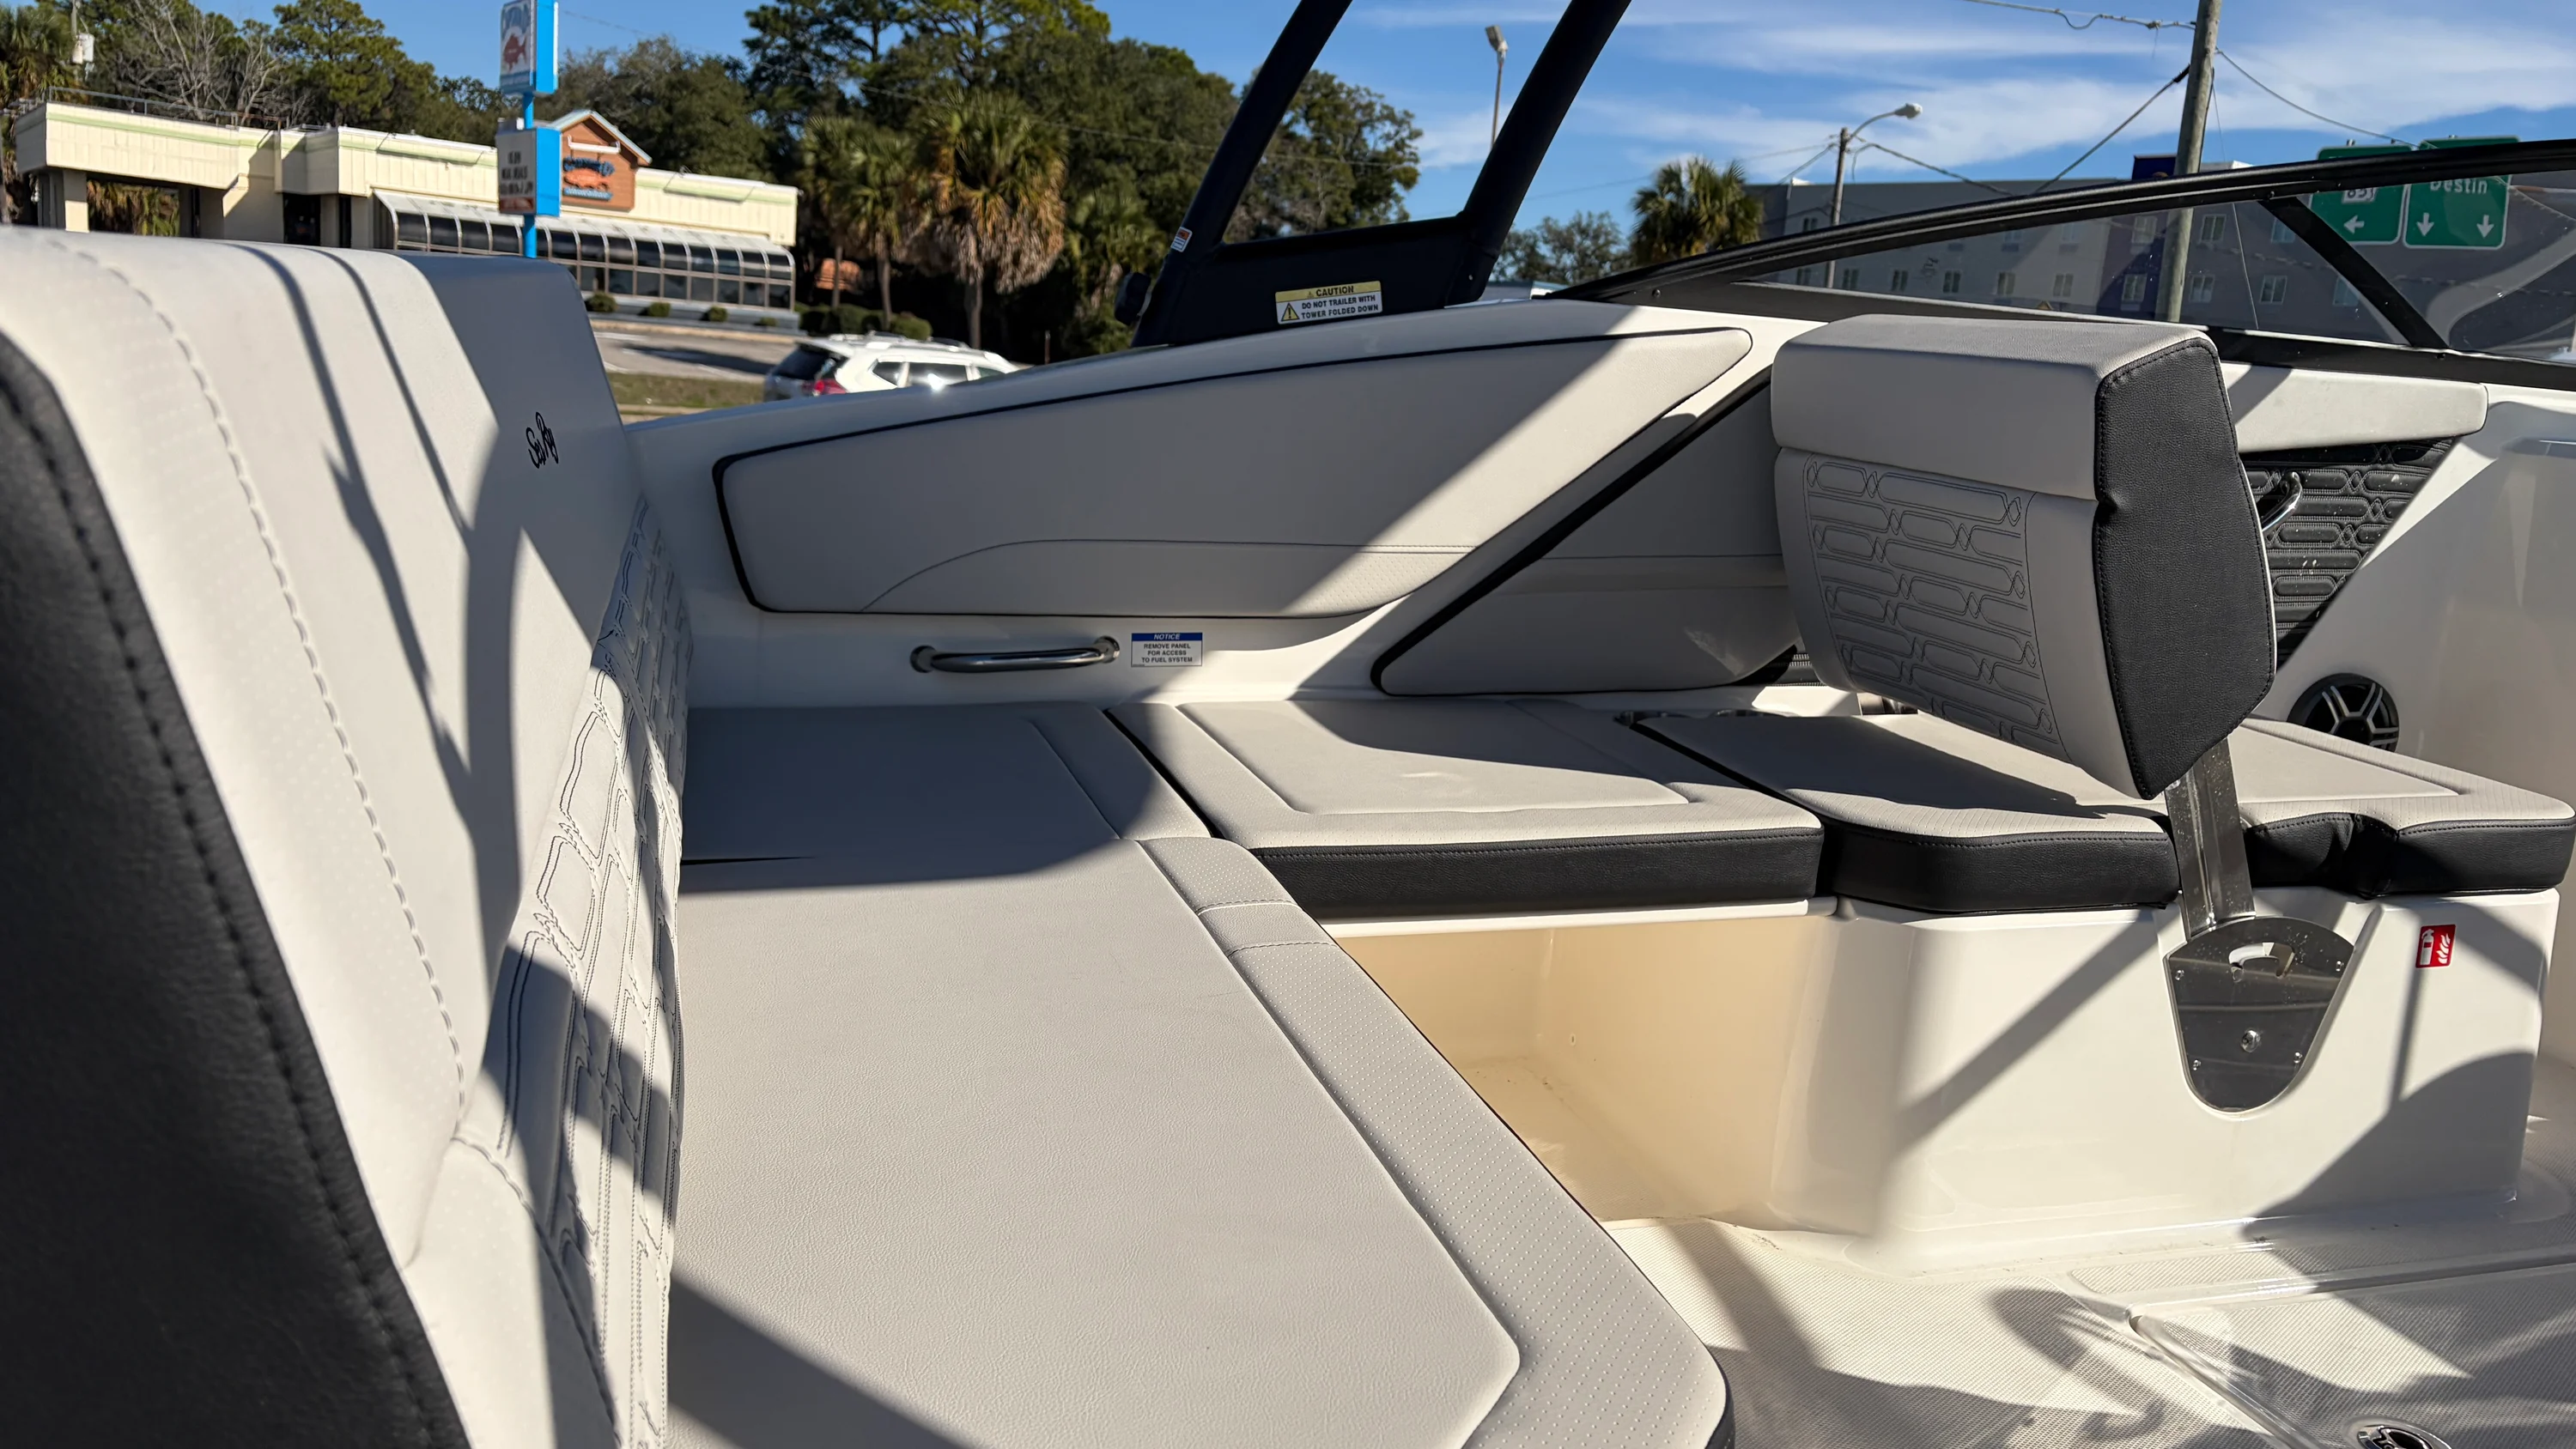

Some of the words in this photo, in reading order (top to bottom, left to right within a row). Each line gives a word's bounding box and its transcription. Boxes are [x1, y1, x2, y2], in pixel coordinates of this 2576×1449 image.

[1315, 286, 1354, 297] CAUTION
[1329, 297, 1357, 306] TRAILER
[1358, 294, 1376, 303] WITH
[1301, 310, 1326, 319] TOWER
[1328, 307, 1355, 317] FOLDED
[1358, 304, 1378, 312] DOWN
